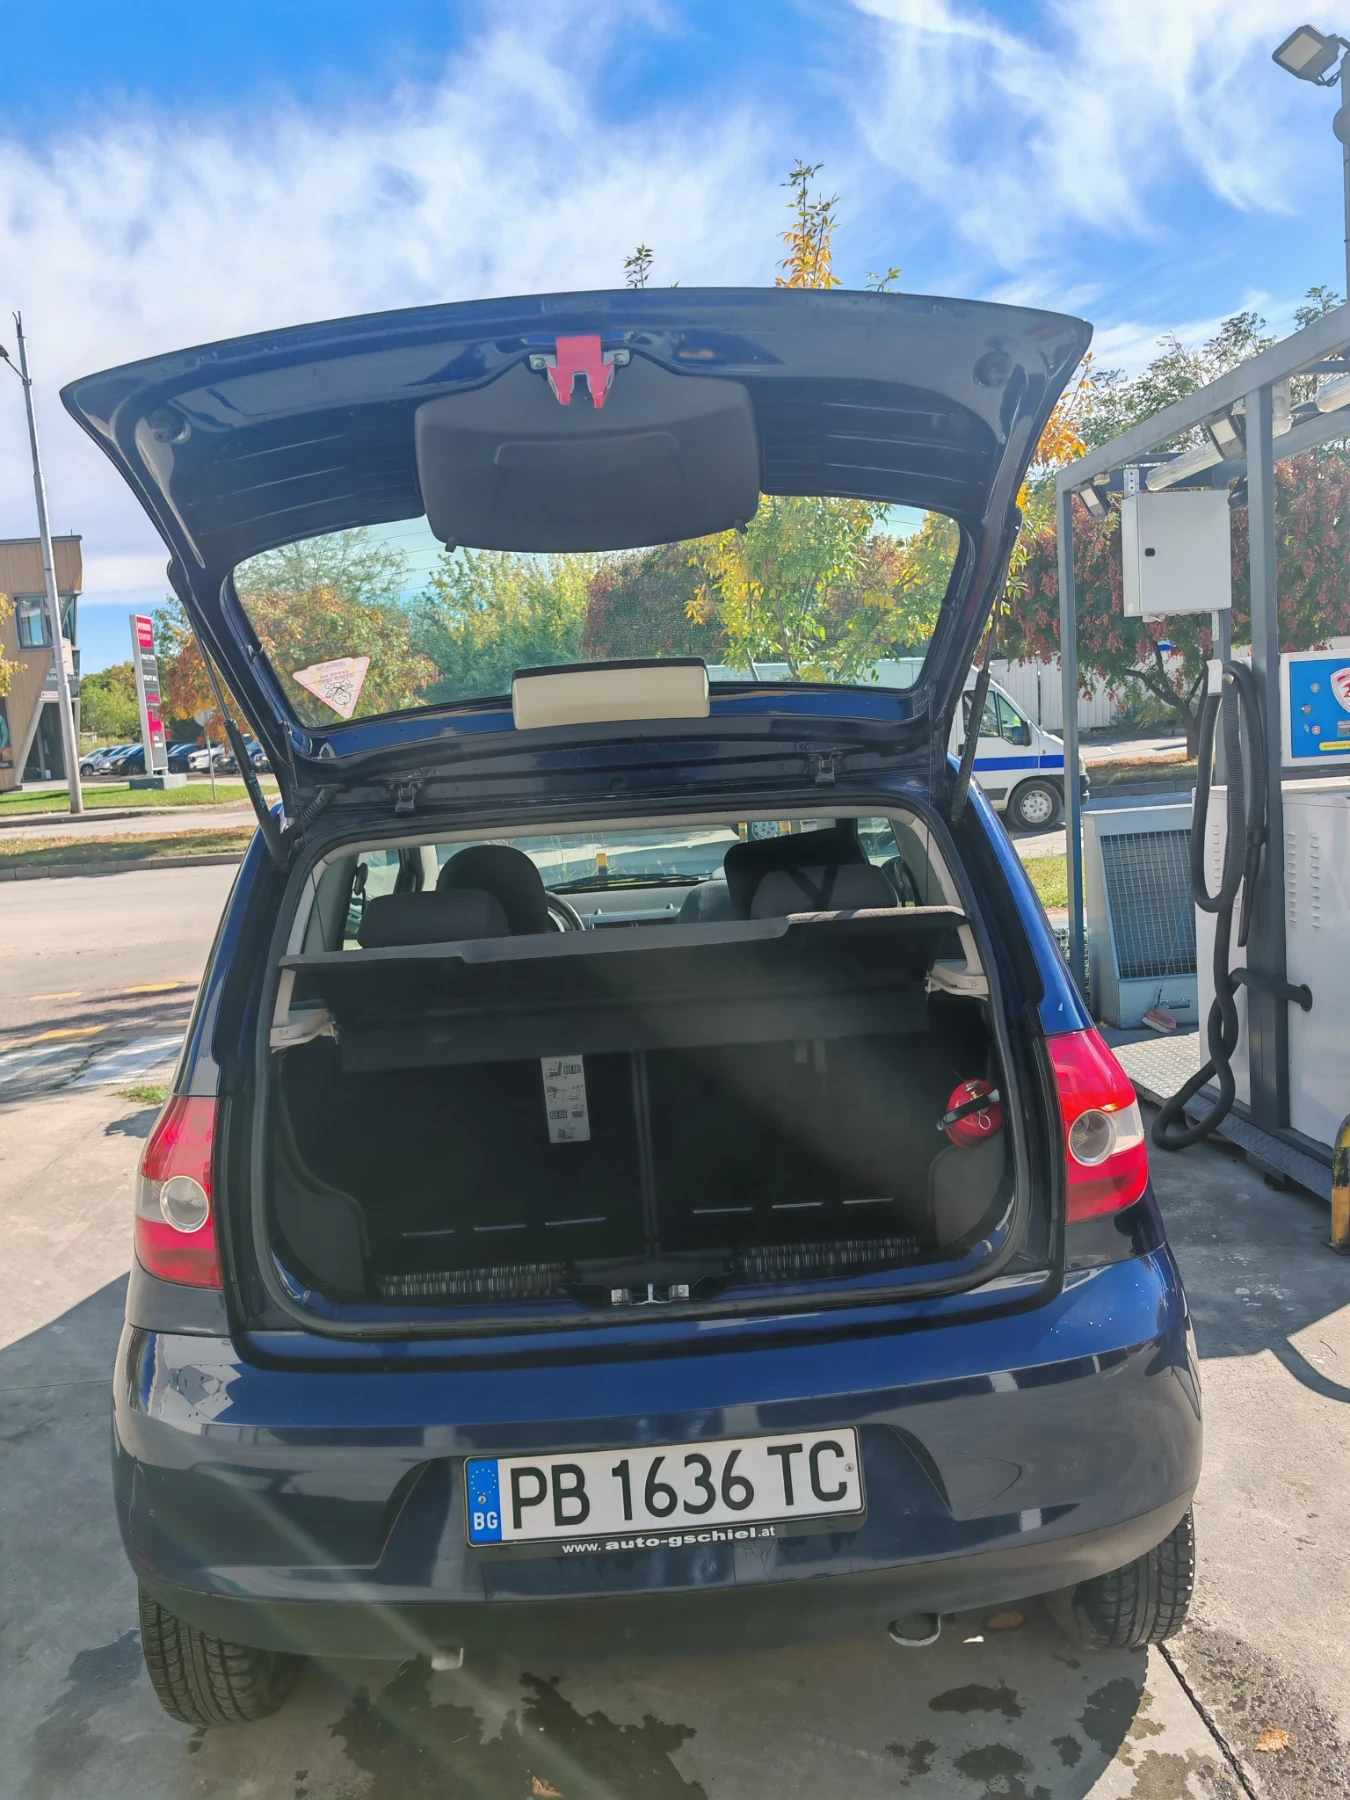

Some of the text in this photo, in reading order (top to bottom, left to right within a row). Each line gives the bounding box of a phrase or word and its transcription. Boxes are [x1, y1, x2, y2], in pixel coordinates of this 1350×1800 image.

[510, 1440, 848, 1530] PB 1636 TC
[473, 1511, 498, 1531] BG
